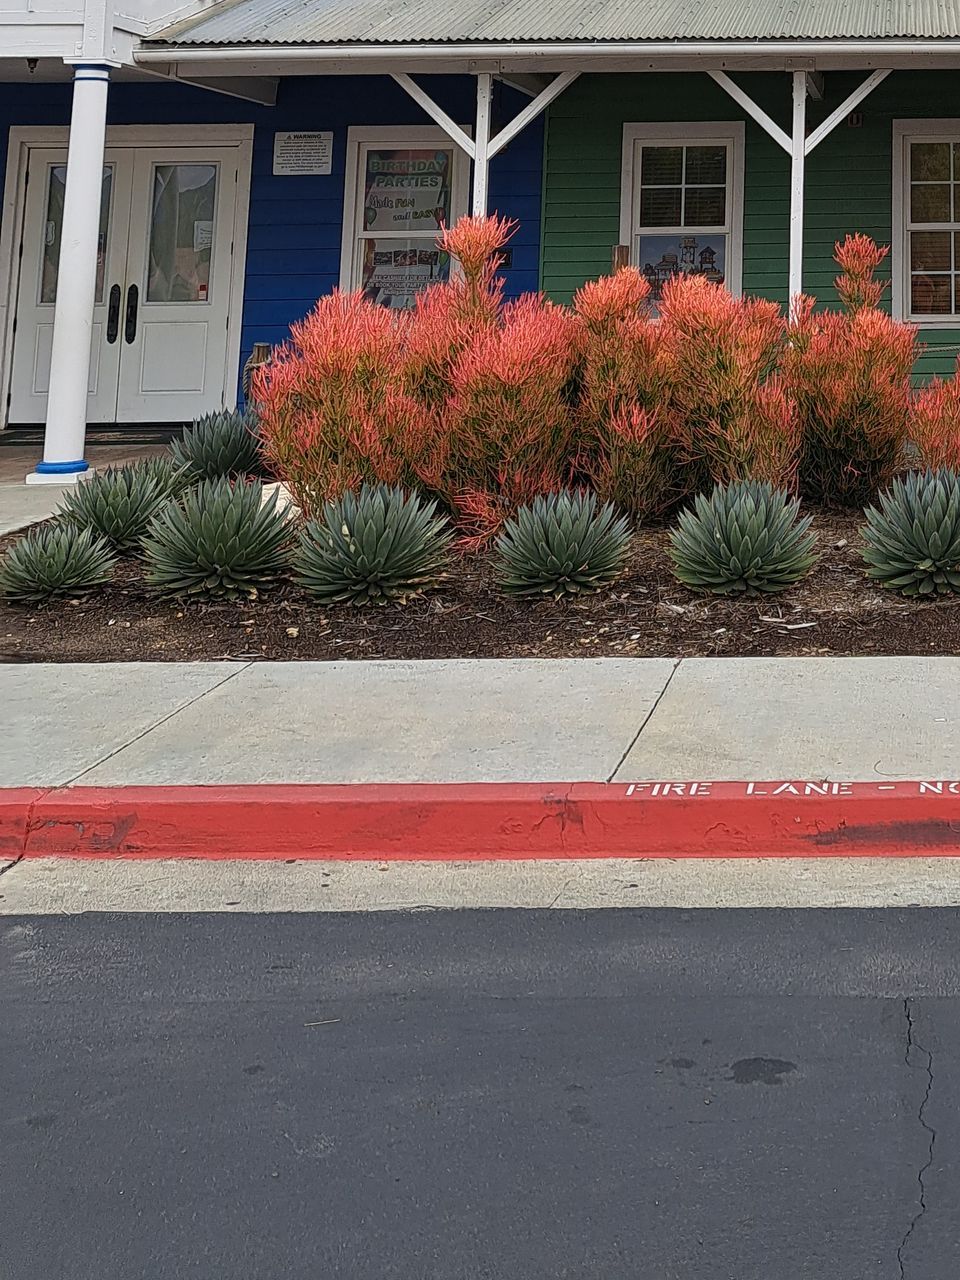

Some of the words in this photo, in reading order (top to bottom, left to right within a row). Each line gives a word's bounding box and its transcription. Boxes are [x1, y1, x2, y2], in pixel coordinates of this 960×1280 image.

[369, 160, 446, 172] BIRTHDAY
[375, 175, 439, 188] PARTIES
[369, 194, 394, 209] Made
[395, 198, 415, 209] FUN
[625, 782, 713, 796] FIRE
[746, 782, 853, 795] LANE
